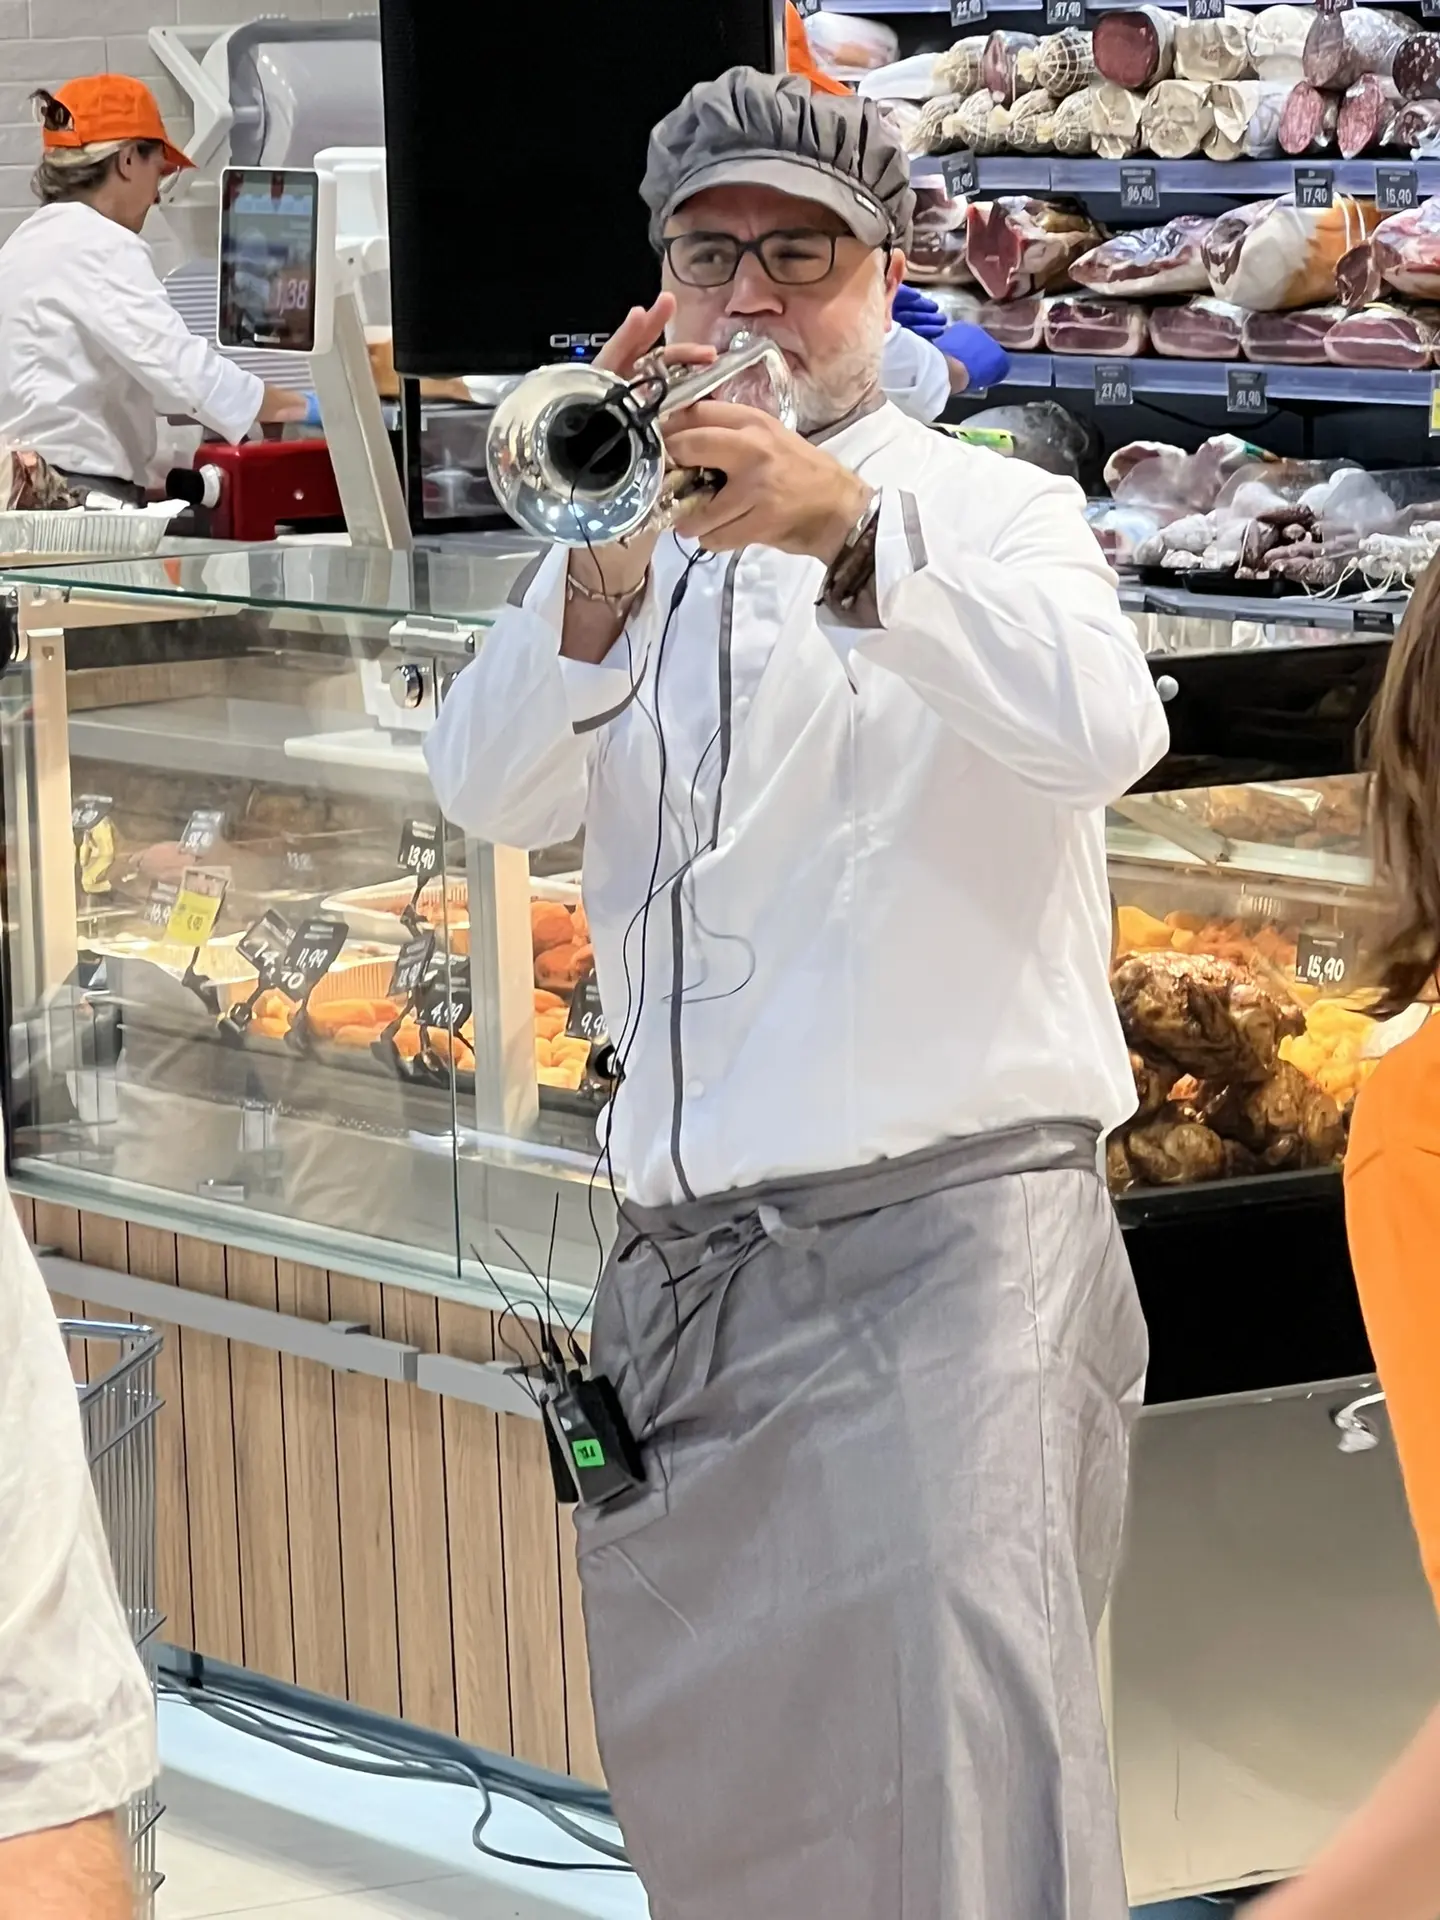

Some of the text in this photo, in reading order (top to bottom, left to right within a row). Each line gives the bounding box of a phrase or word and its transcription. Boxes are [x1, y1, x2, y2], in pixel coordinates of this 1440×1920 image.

[1303, 187, 1328, 204] 17,90
[407, 844, 436, 873] 13,90
[295, 947, 328, 968] 11,99
[1307, 954, 1345, 985] 15,90
